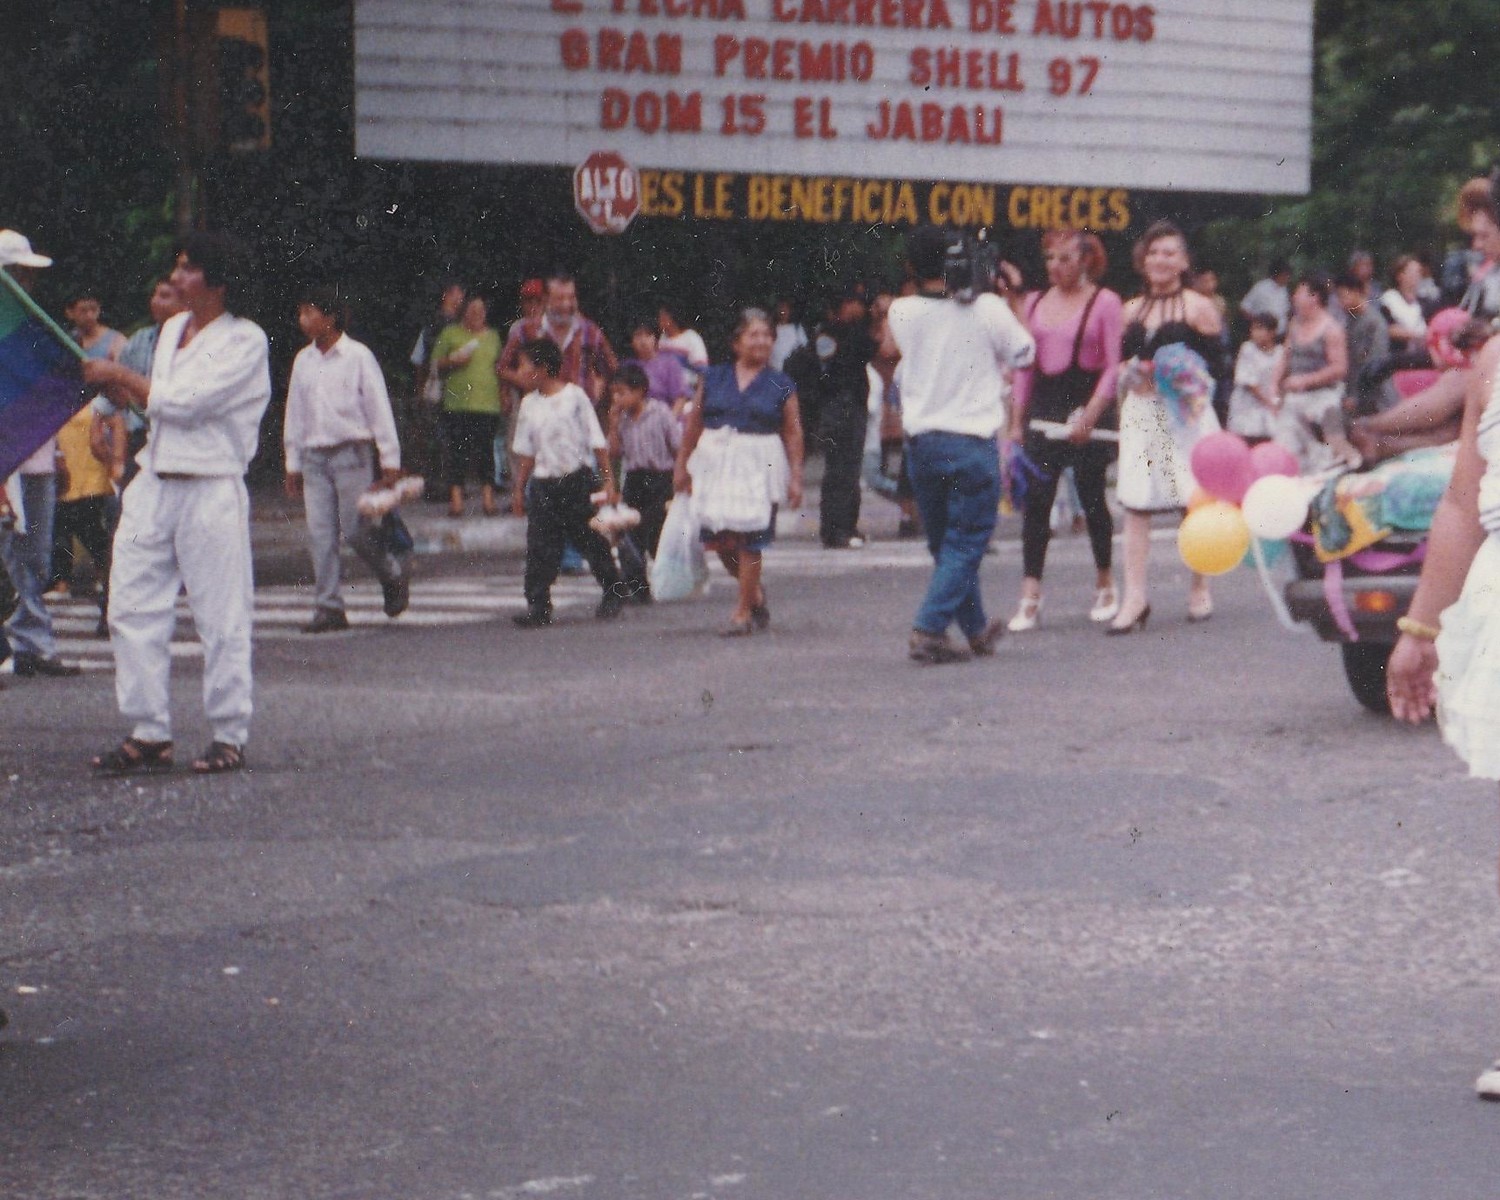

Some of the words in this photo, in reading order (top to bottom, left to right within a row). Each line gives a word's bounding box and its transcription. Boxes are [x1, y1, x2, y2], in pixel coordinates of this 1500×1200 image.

[969, 0, 1018, 35] DE
[1033, 0, 1158, 42] AUTOS
[560, 28, 683, 75] GRAN
[714, 34, 876, 82] PREMIO
[910, 47, 1026, 93] SHELL
[1047, 55, 1101, 97] 97
[601, 89, 703, 134] DOM
[719, 93, 767, 137] 15
[794, 96, 837, 140] EL
[866, 100, 1004, 146] JABALI
[580, 166, 634, 201] ALTO
[640, 172, 685, 217] ES
[694, 174, 734, 219] LE
[747, 175, 918, 224] BENEFICIA
[929, 182, 995, 227] CON
[1008, 186, 1131, 231] CRECES
